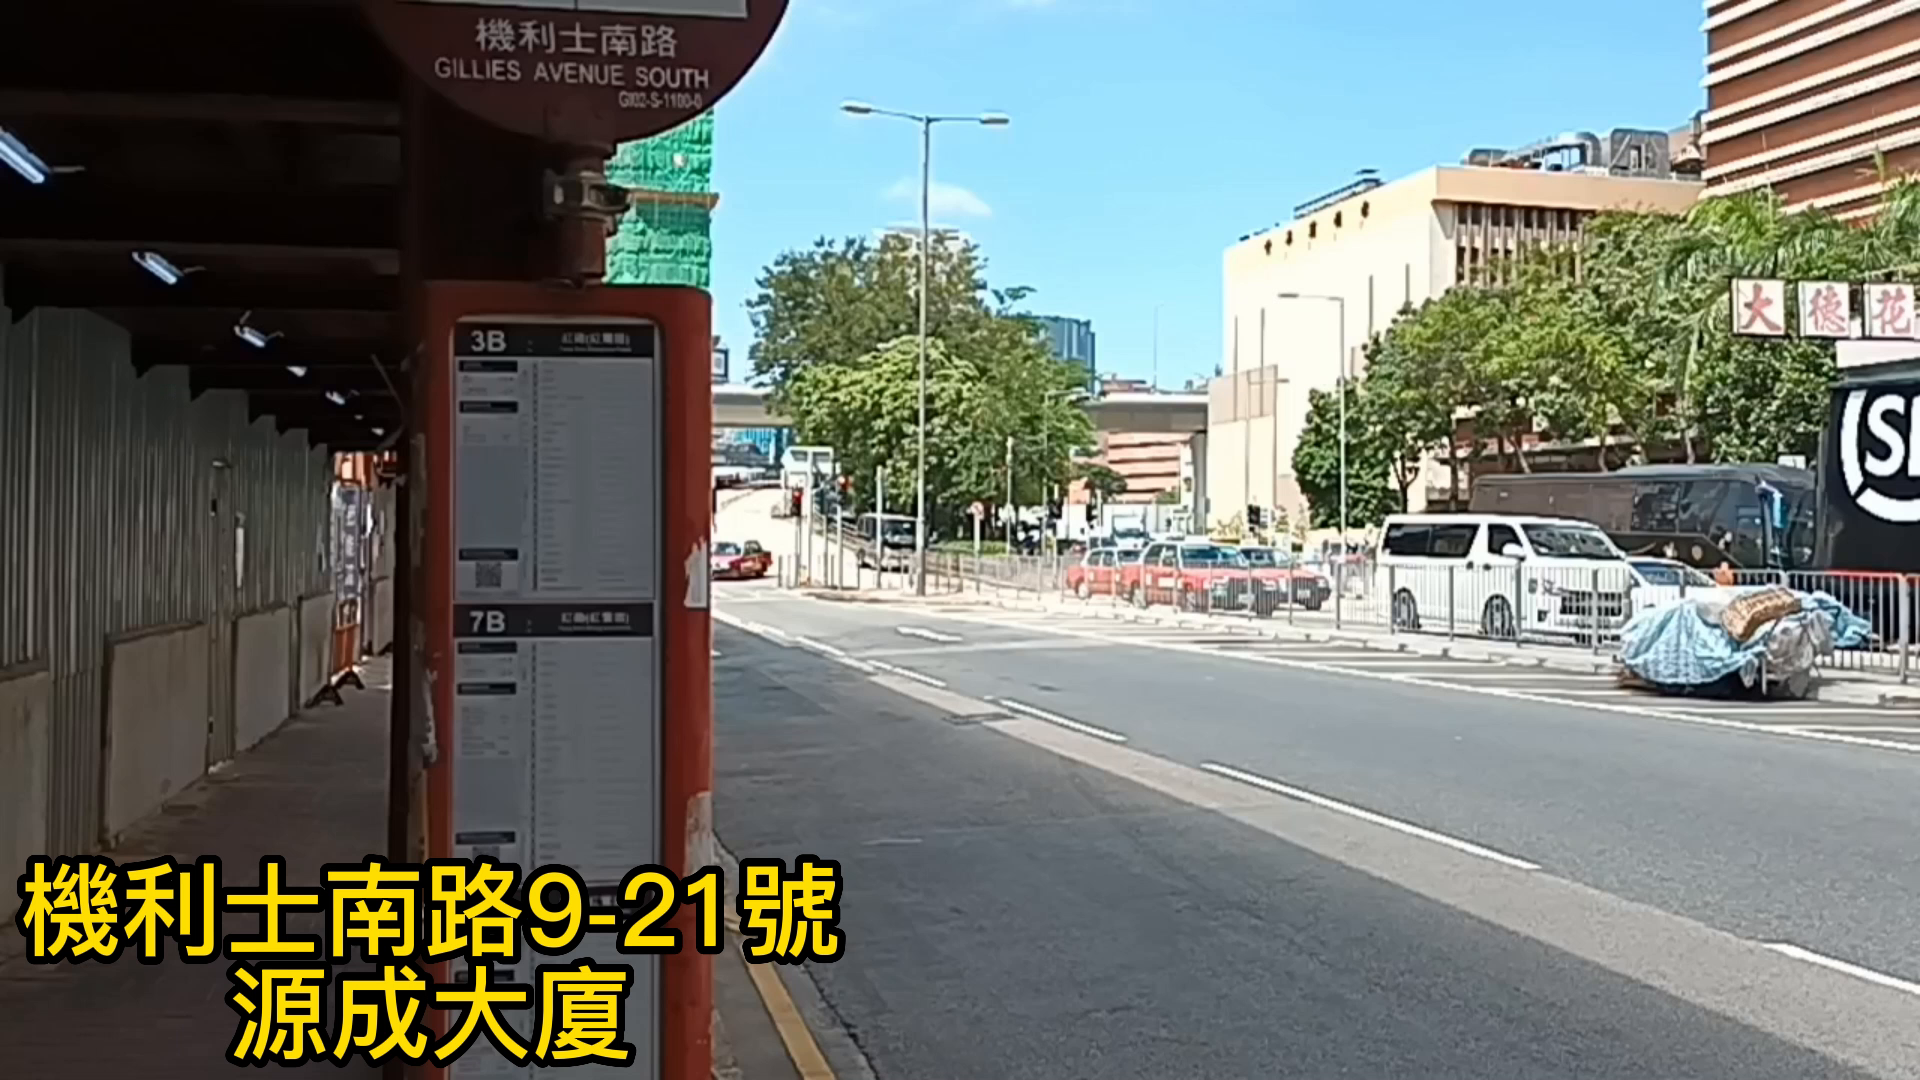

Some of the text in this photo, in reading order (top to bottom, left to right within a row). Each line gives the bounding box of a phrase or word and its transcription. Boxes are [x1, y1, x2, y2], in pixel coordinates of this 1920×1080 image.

[475, 18, 678, 59] 機利士南路
[434, 56, 710, 89] GILLIES AVENUE SOUTH
[470, 330, 507, 353] 3B
[469, 610, 505, 634] 7B
